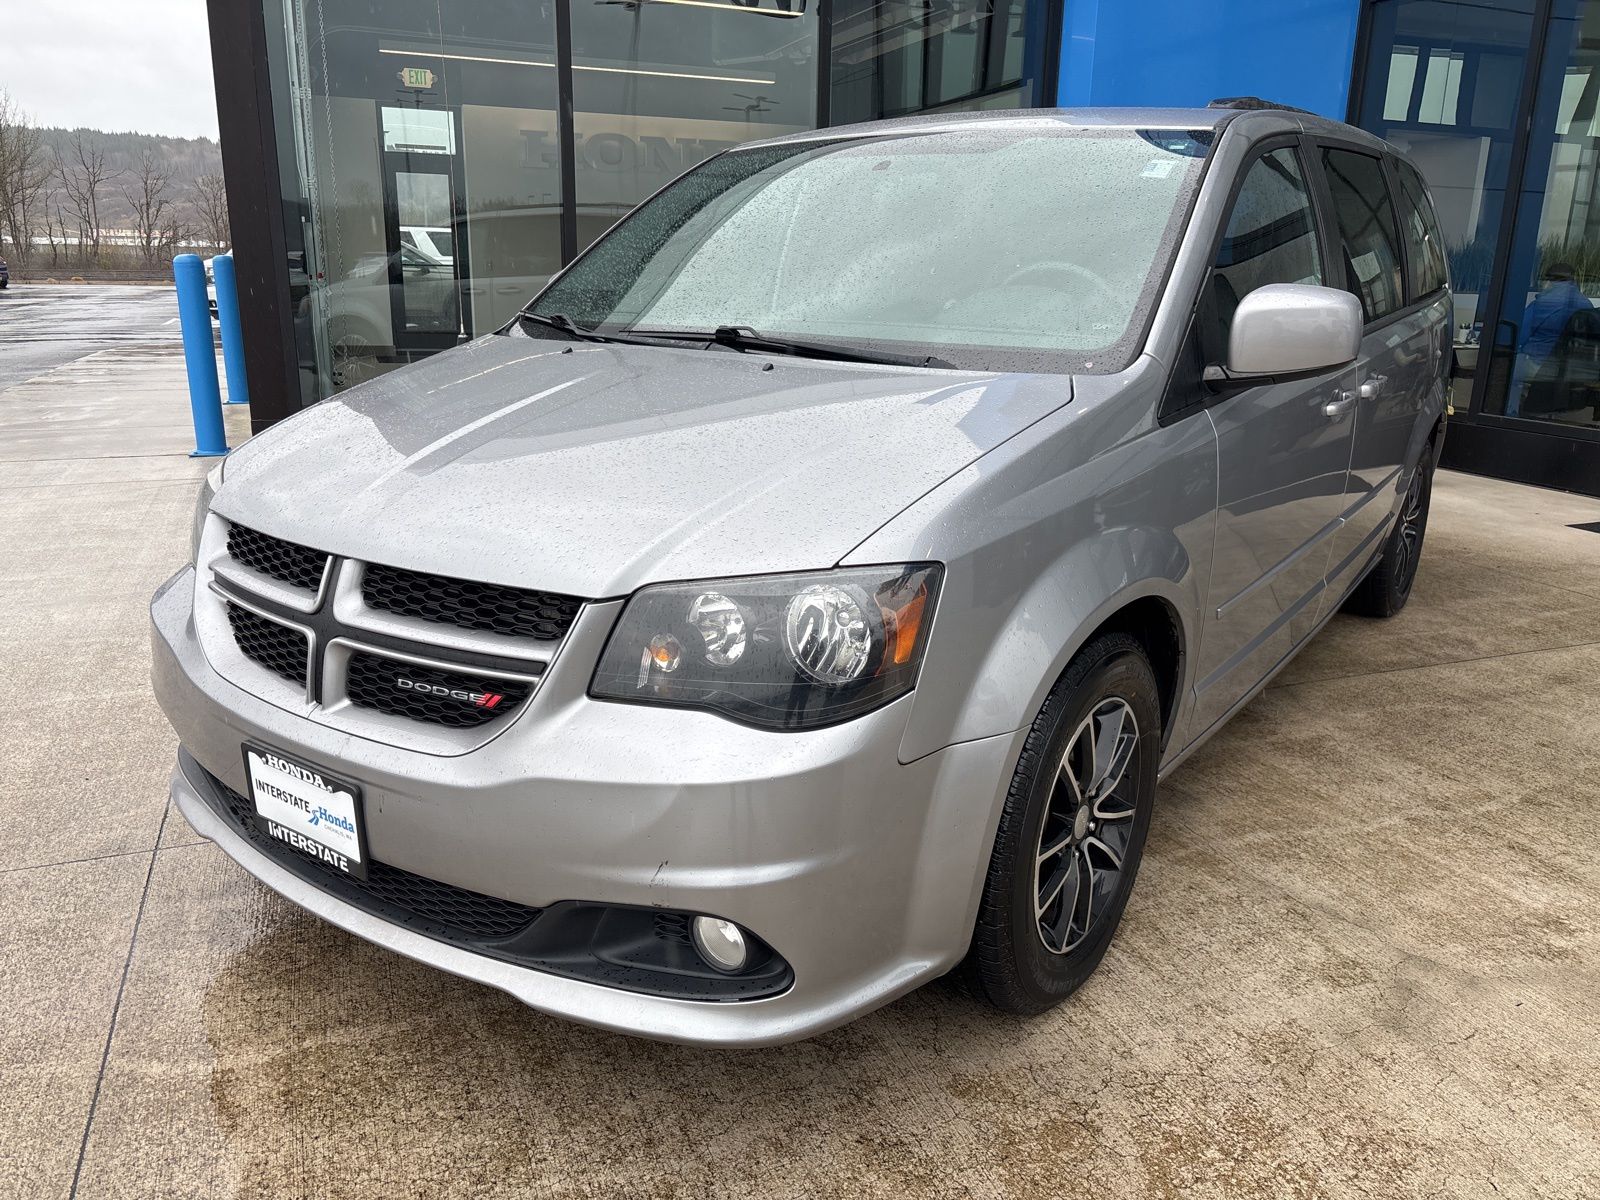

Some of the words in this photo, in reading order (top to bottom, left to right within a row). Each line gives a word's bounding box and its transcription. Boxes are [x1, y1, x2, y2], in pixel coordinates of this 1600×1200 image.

[408, 69, 428, 86] EXIT
[519, 129, 738, 173] HON
[397, 678, 487, 704] DODGE
[265, 753, 326, 791] HONDA
[255, 778, 311, 814] INTERSTATE
[317, 806, 355, 834] Honda
[268, 820, 349, 873] INTERSTATE
